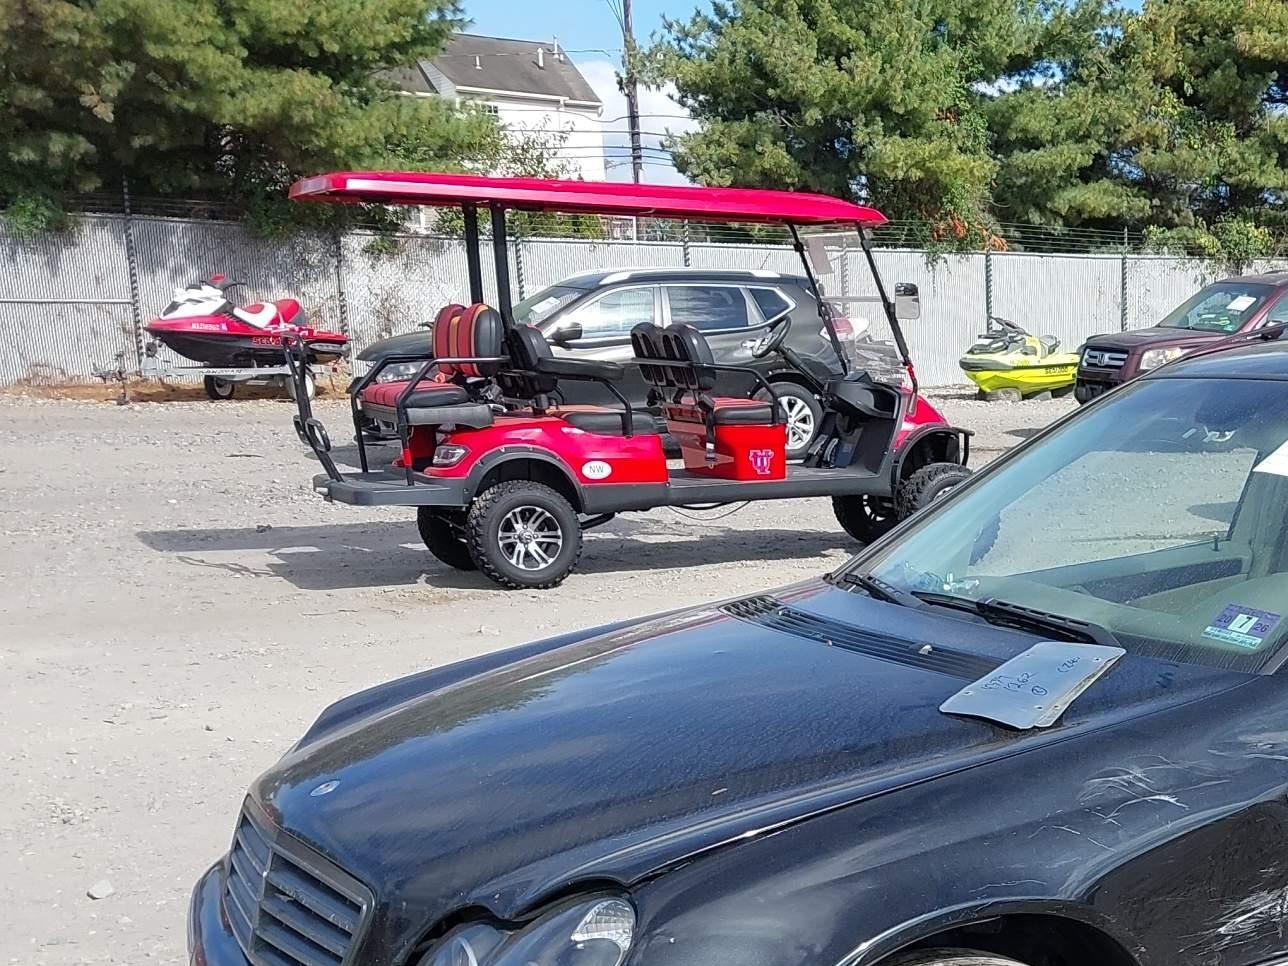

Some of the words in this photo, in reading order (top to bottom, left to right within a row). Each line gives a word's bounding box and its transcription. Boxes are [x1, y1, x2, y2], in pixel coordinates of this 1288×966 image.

[589, 465, 604, 474] NW
[1217, 614, 1233, 624] 20
[1238, 616, 1253, 629] 7
[1254, 622, 1270, 633] 26
